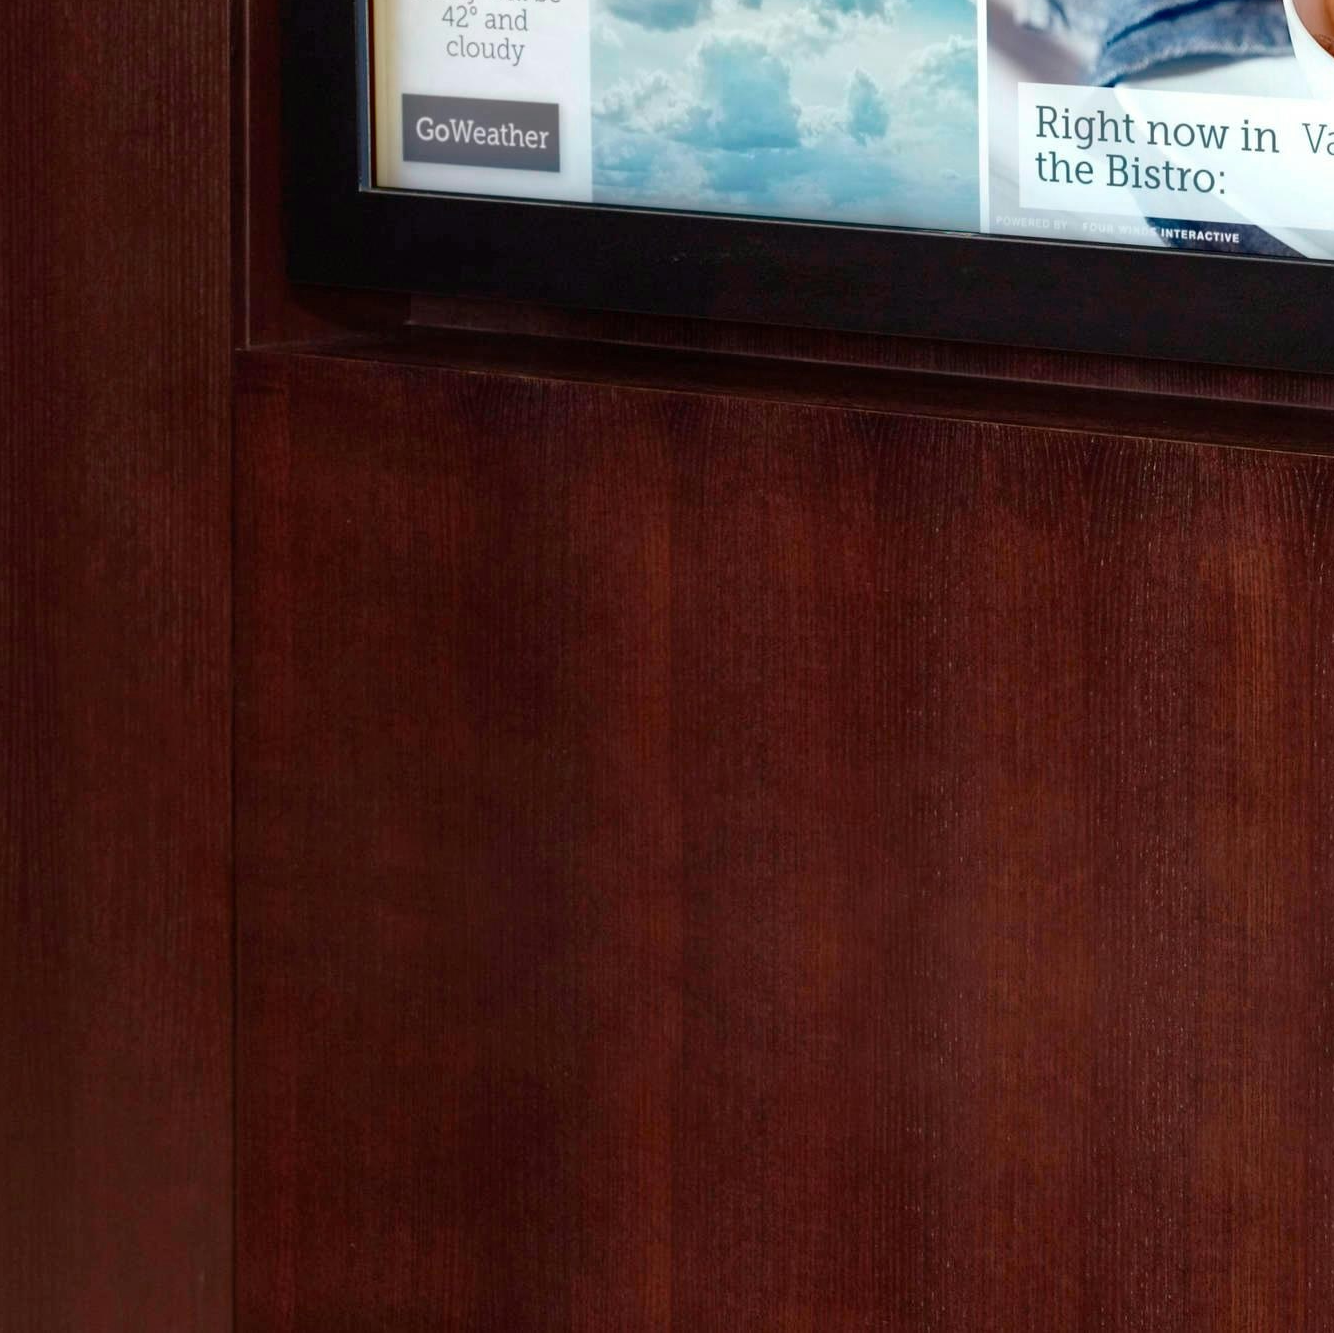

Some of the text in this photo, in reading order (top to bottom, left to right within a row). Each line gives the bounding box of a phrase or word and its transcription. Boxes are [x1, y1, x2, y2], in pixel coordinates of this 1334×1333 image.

[484, 8, 528, 33] and
[446, 35, 525, 67] cloudy
[415, 116, 550, 151] GoWeather
[1035, 104, 1279, 154] Right now in
[1035, 151, 1228, 197] the Bistro:
[1083, 222, 1113, 233] FOUR
[1161, 228, 1240, 243] INTERACTIVE
